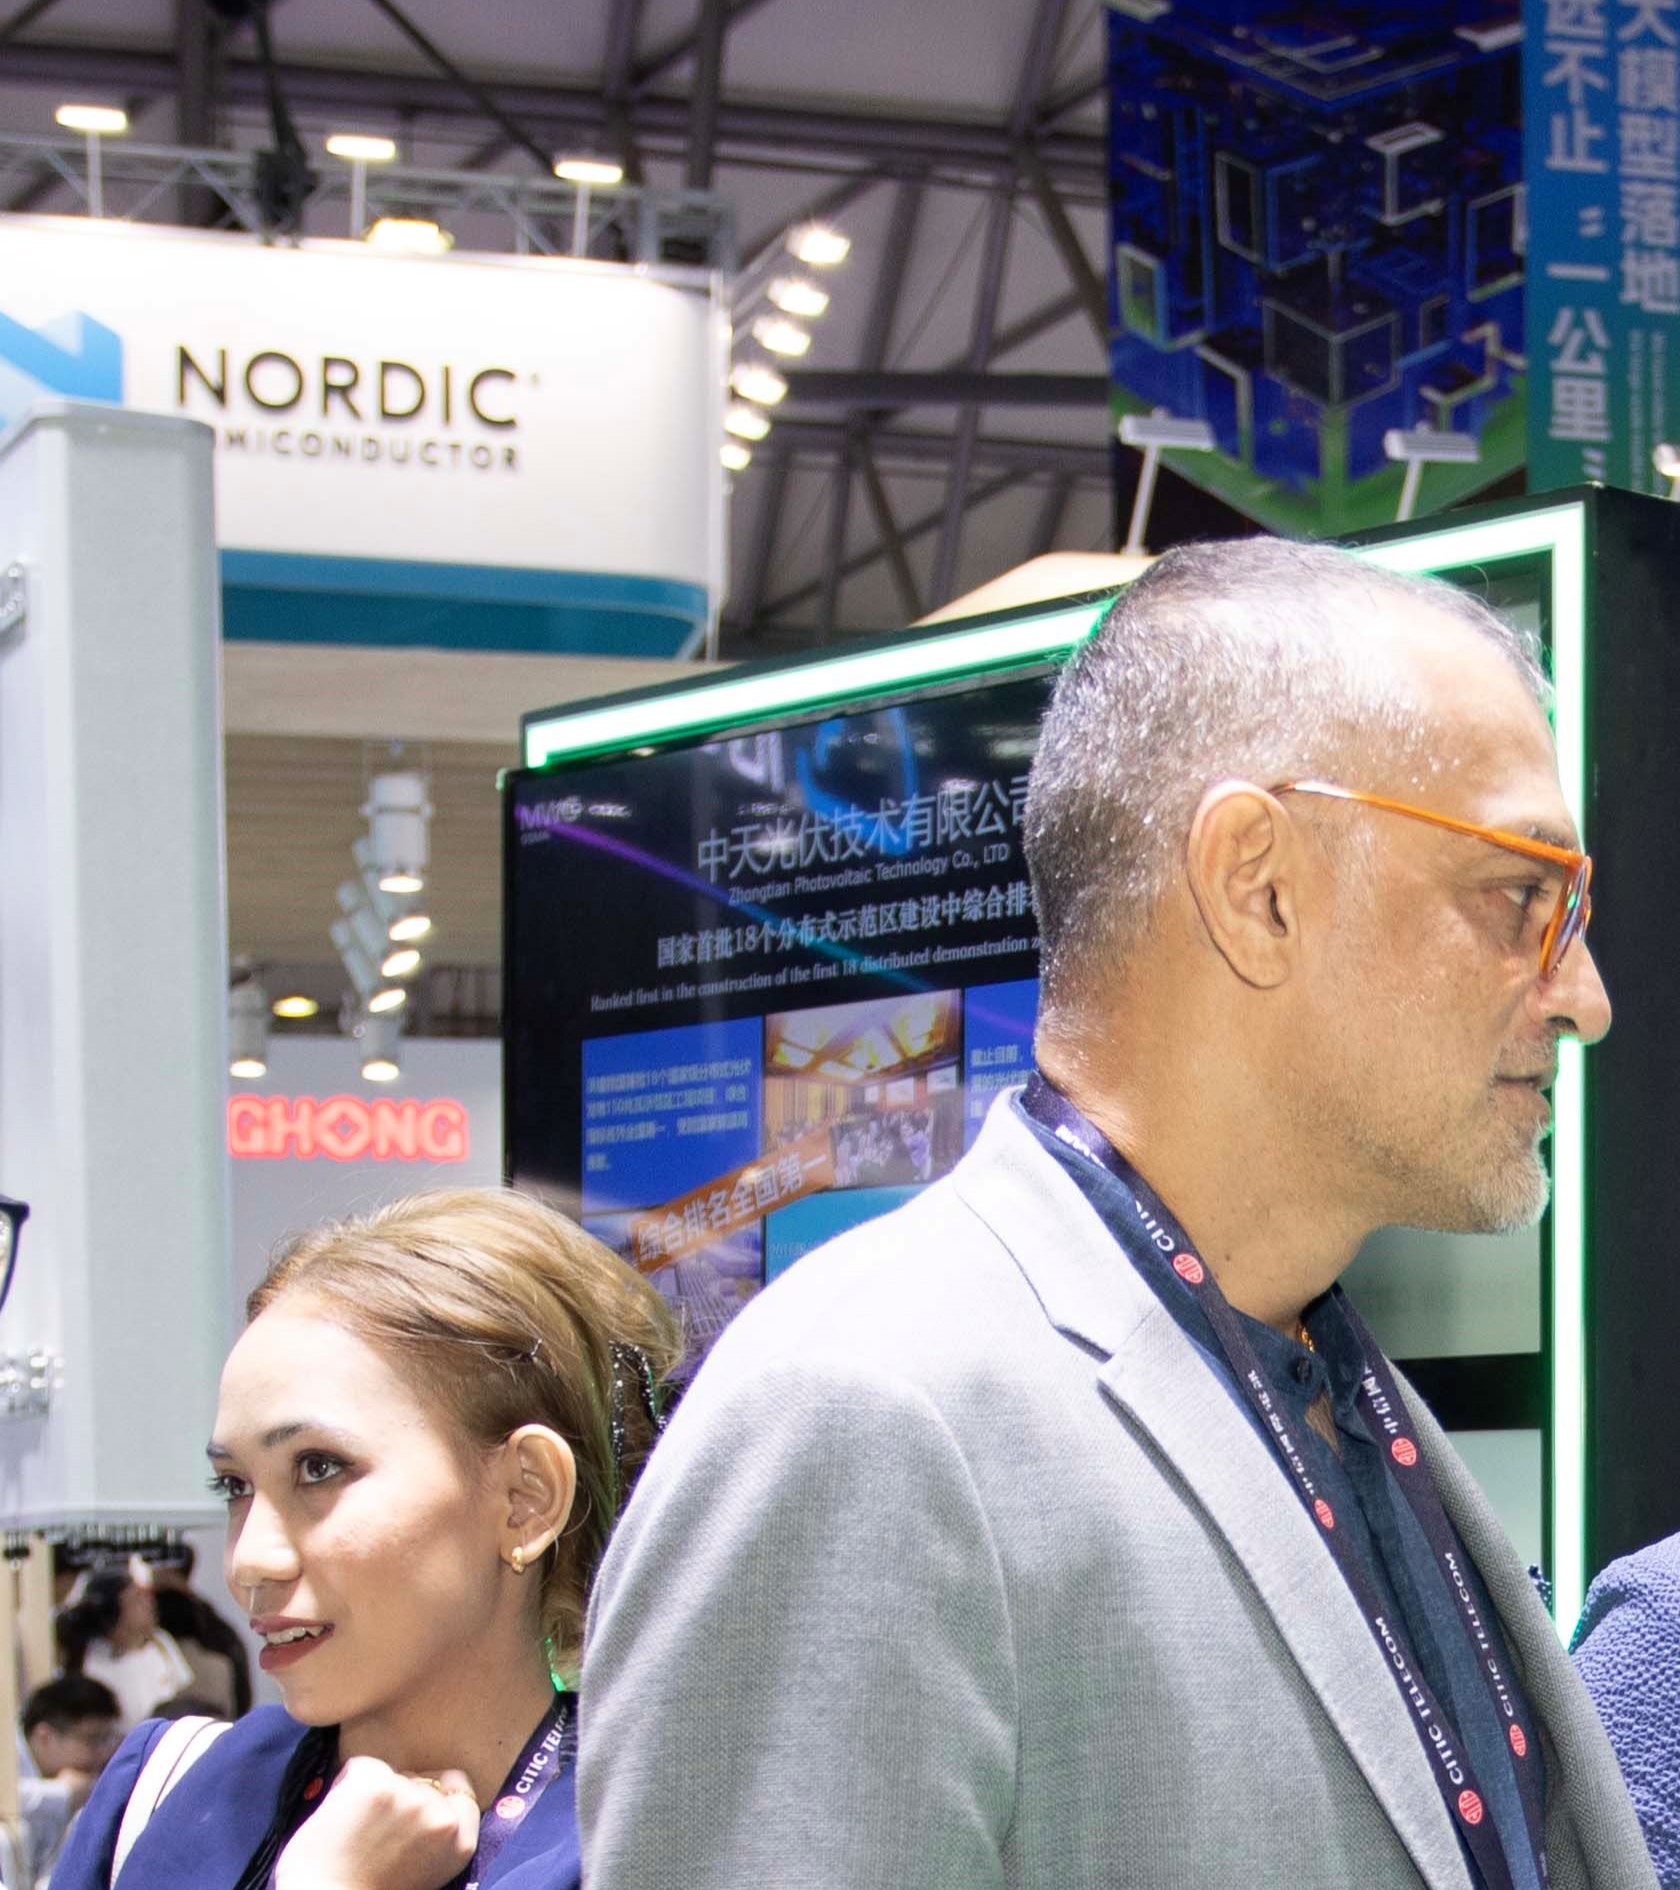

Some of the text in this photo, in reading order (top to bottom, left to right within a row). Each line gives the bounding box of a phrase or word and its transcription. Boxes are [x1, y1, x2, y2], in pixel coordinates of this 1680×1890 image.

[176, 345, 518, 429] NORDIC
[220, 428, 519, 472] MICONDUCTOR
[876, 851, 949, 884] Technology
[982, 842, 1011, 864] LTD
[675, 982, 696, 1000] the
[774, 967, 788, 985] of
[790, 964, 810, 983] the
[812, 961, 838, 979] first
[842, 959, 857, 976] 18
[859, 949, 930, 974] distributed
[932, 936, 1028, 963] demonstration
[1443, 1551, 1514, 1719] CITIC TELECOM
[1374, 1615, 1465, 1786] CITIC TELECOM
[515, 1746, 552, 1794] CITIC
